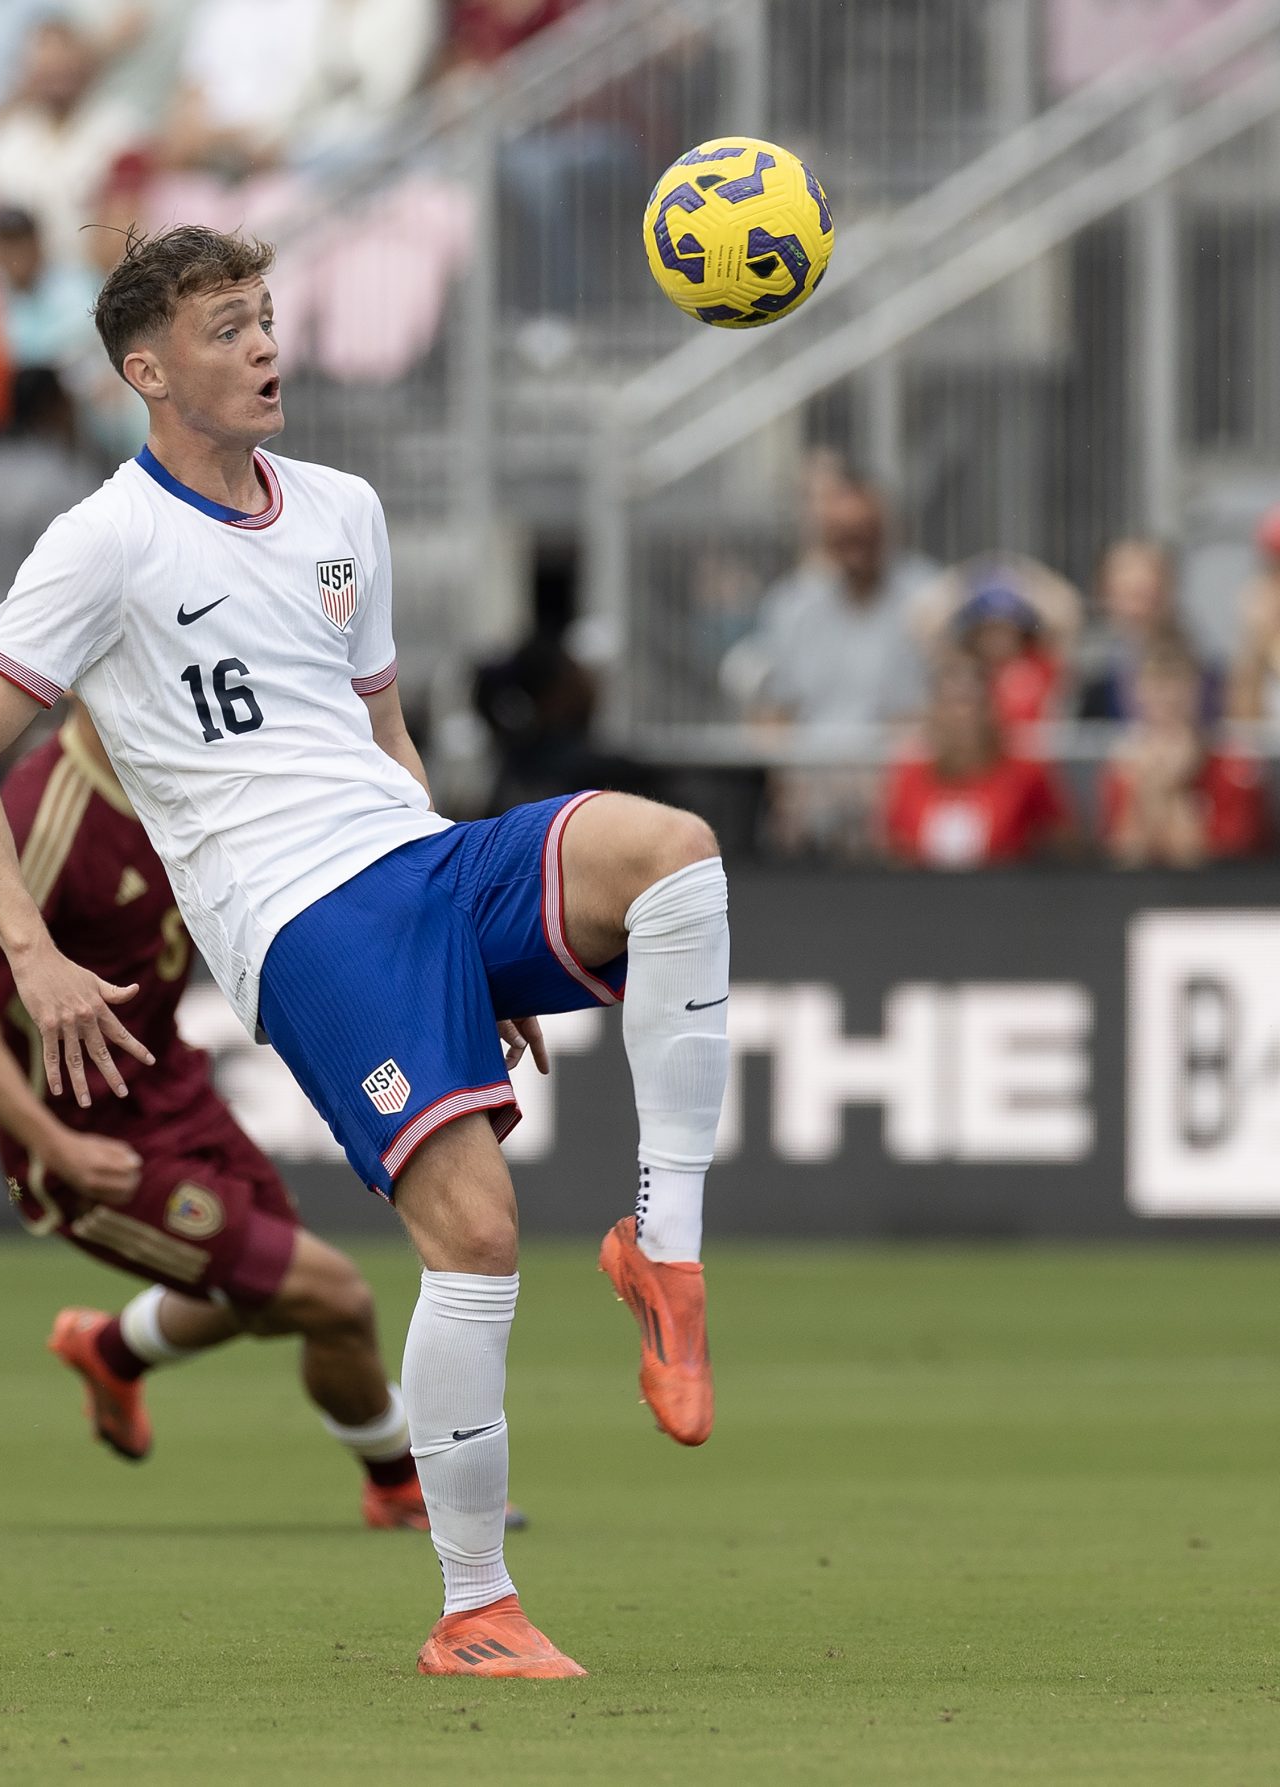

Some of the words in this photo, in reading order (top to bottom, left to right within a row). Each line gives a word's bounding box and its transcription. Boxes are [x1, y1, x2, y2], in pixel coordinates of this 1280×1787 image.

[320, 563, 353, 591] USA
[180, 657, 264, 743] 16
[365, 1062, 397, 1094] USA
